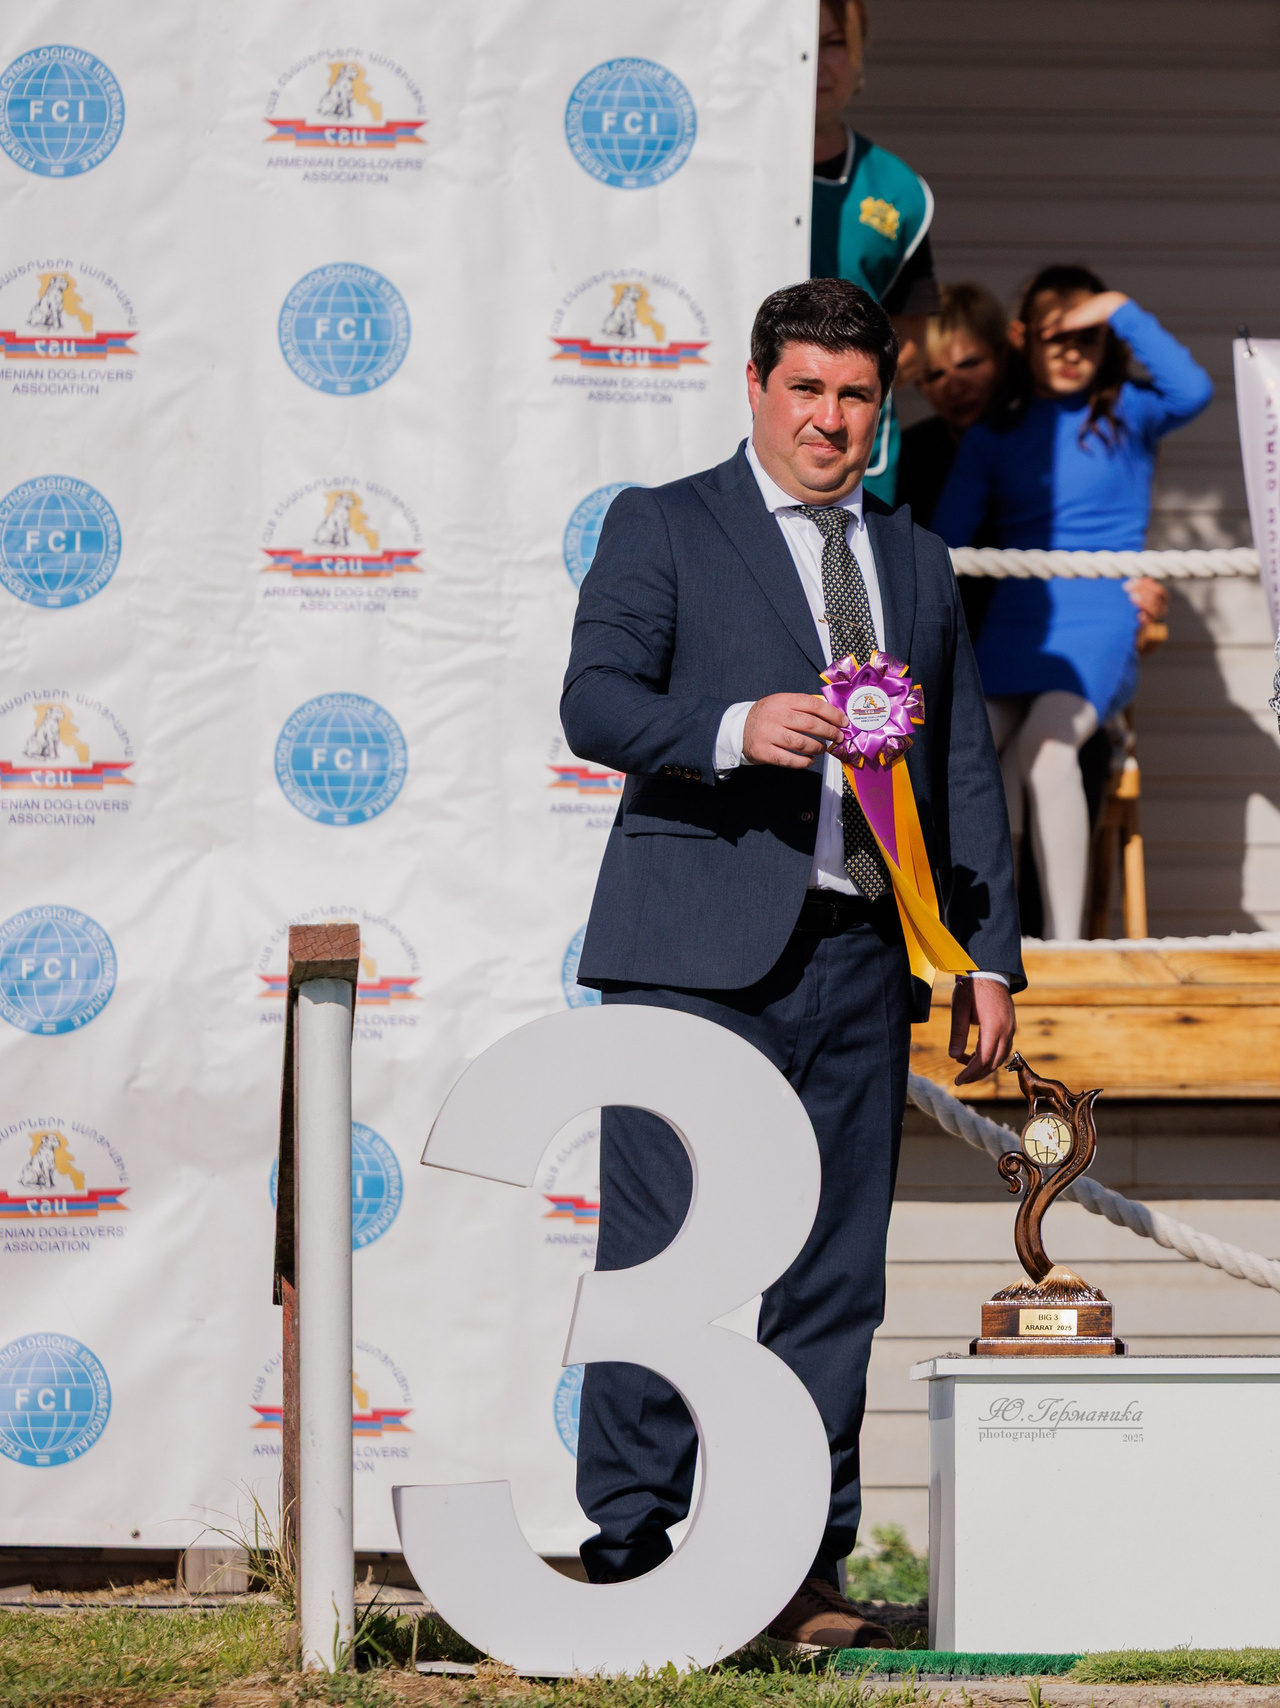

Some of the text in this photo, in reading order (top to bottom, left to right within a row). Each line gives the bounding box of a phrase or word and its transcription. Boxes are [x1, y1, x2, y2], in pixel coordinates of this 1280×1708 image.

[1, 47, 94, 89] CYNOLOGIQUE
[80, 63, 122, 170] INTERNATIONALE
[30, 101, 84, 122] FCI
[602, 112, 658, 134] FCI
[267, 157, 334, 169] ARMENIAN
[302, 171, 389, 184] ASSOCIATION
[316, 318, 371, 340] FCI
[0, 368, 44, 380] MENIAN
[12, 383, 99, 395] ASSOCIATION
[1266, 392, 1278, 492] QUALIT
[26, 531, 81, 553] FCI
[76, 493, 119, 600] INTERNATIONALE
[313, 748, 368, 770] FCI
[1, 800, 40, 811] ENIAN
[9, 813, 95, 825] ASSOCIATION
[0, 907, 86, 938] YNOLOGIQUE
[22, 958, 77, 980] FCI
[4, 1241, 90, 1253] ASSOCIATION
[391, 1004, 832, 1679] 3
[15, 1388, 71, 1411] FCI
[64, 1350, 108, 1460] INTERNATIONALE
